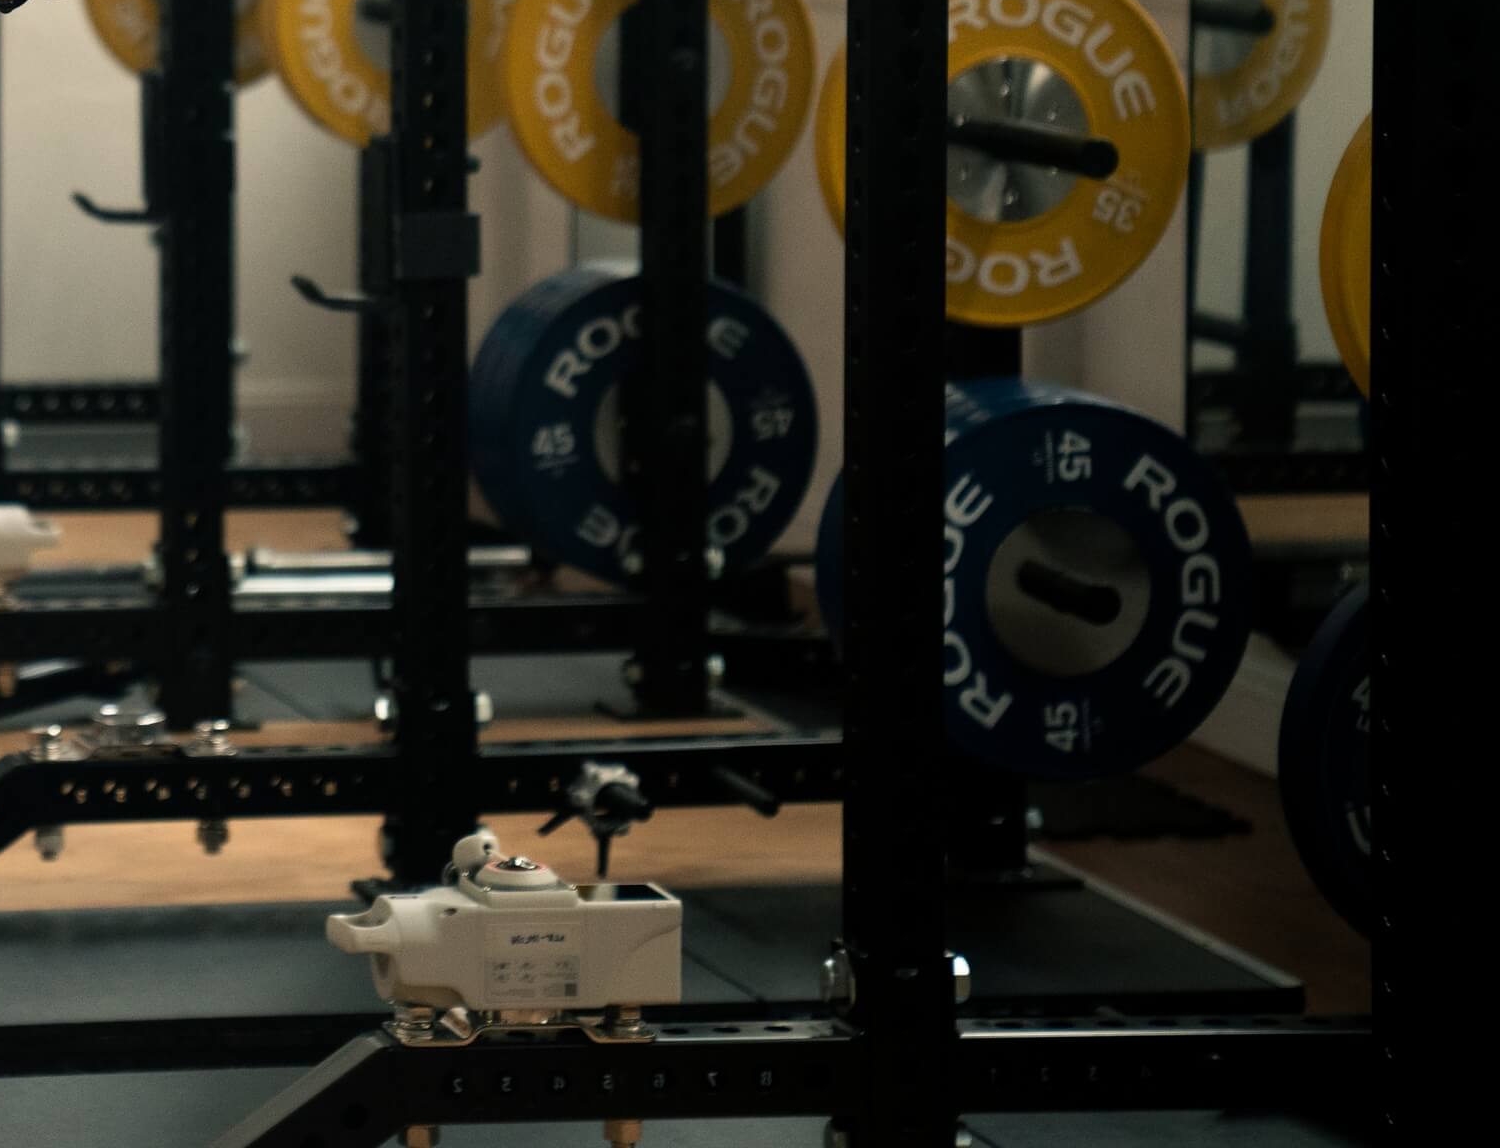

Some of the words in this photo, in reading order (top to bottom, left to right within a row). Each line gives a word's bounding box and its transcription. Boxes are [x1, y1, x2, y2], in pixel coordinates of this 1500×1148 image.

[1092, 186, 1143, 235] 35
[945, 235, 1084, 297] ROG
[531, 421, 577, 456] 45
[1057, 429, 1093, 483] 45
[1122, 453, 1221, 709] ROGUE
[1044, 700, 1078, 753] 45
